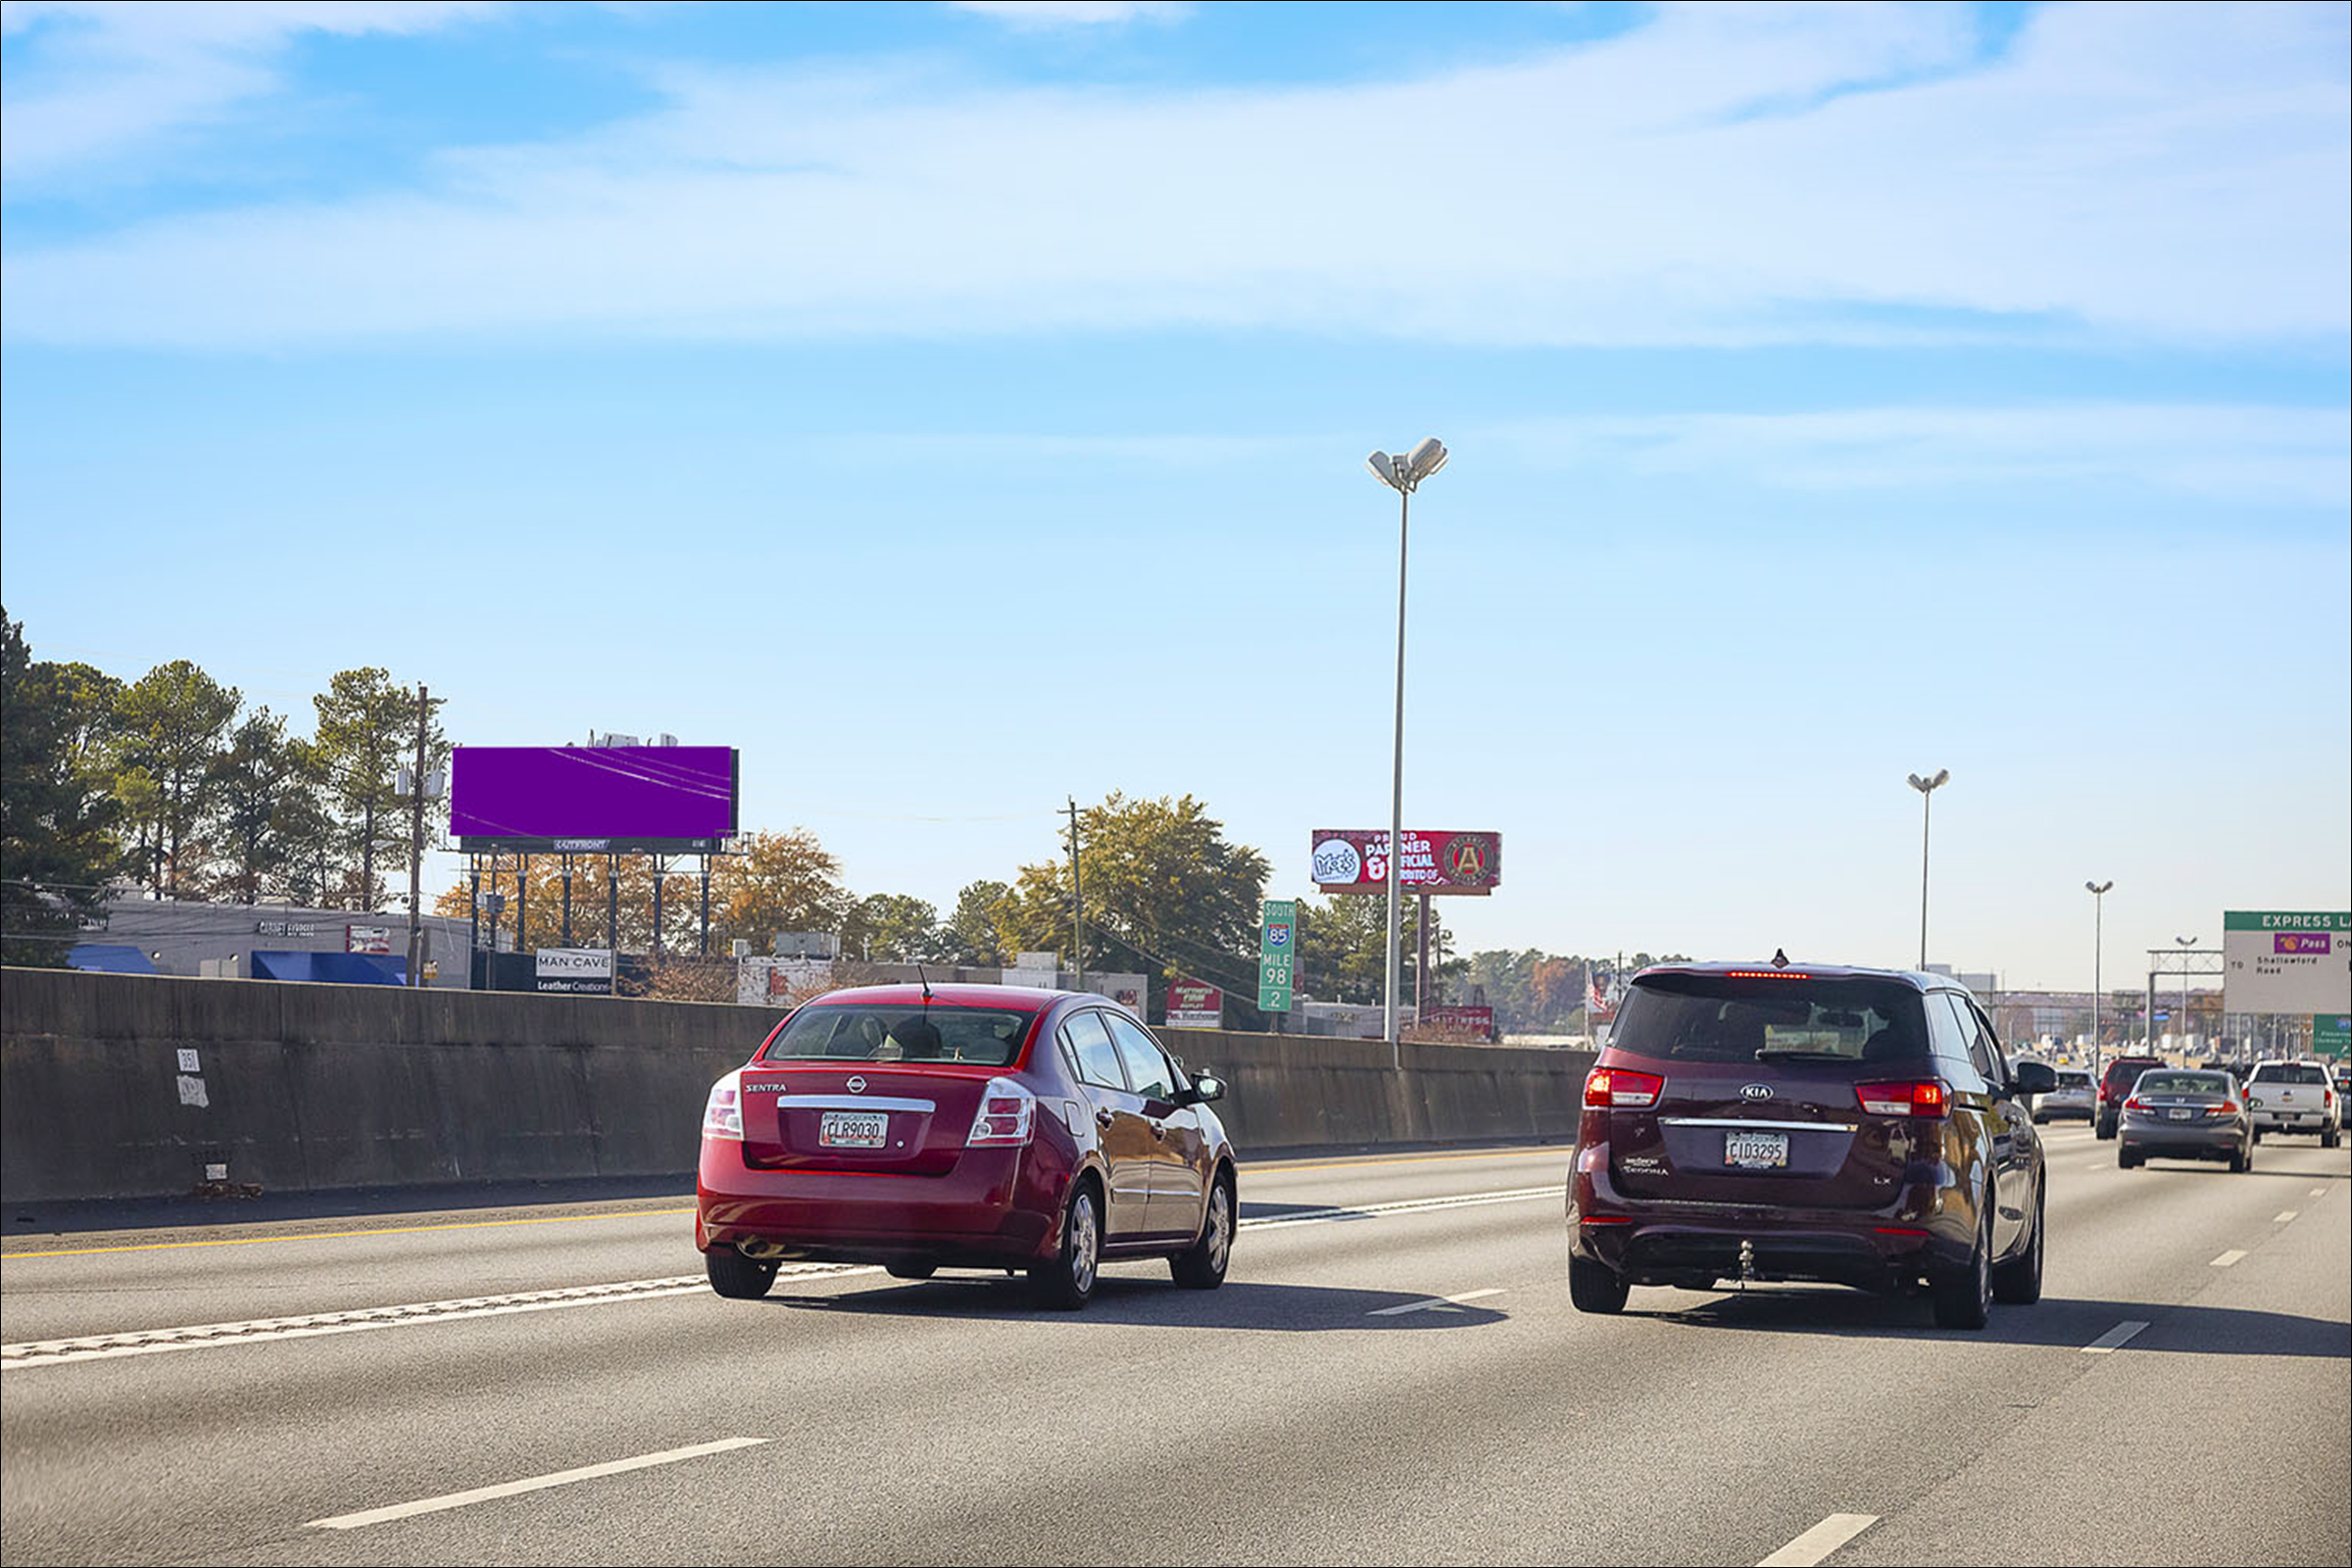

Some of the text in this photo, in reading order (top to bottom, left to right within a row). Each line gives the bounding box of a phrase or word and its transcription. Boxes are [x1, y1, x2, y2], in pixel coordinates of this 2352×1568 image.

[1374, 832, 1417, 843] PRUD
[1365, 841, 1432, 857] PARNER
[1266, 903, 1294, 916] SOUTH
[2262, 914, 2331, 927] EXPRESS
[1269, 928, 1287, 943] 85
[2300, 938, 2326, 949] Pass
[539, 956, 610, 968] MAN CAVE
[1263, 954, 1291, 966] MILE
[2256, 956, 2318, 965] Shallowford
[1266, 967, 1287, 985] 98
[538, 981, 571, 991] Leather
[746, 1083, 787, 1092] SENTRA
[1745, 1087, 1768, 1098] KIA
[827, 1121, 880, 1139] CLR9030
[1730, 1142, 1783, 1160] CID3295
